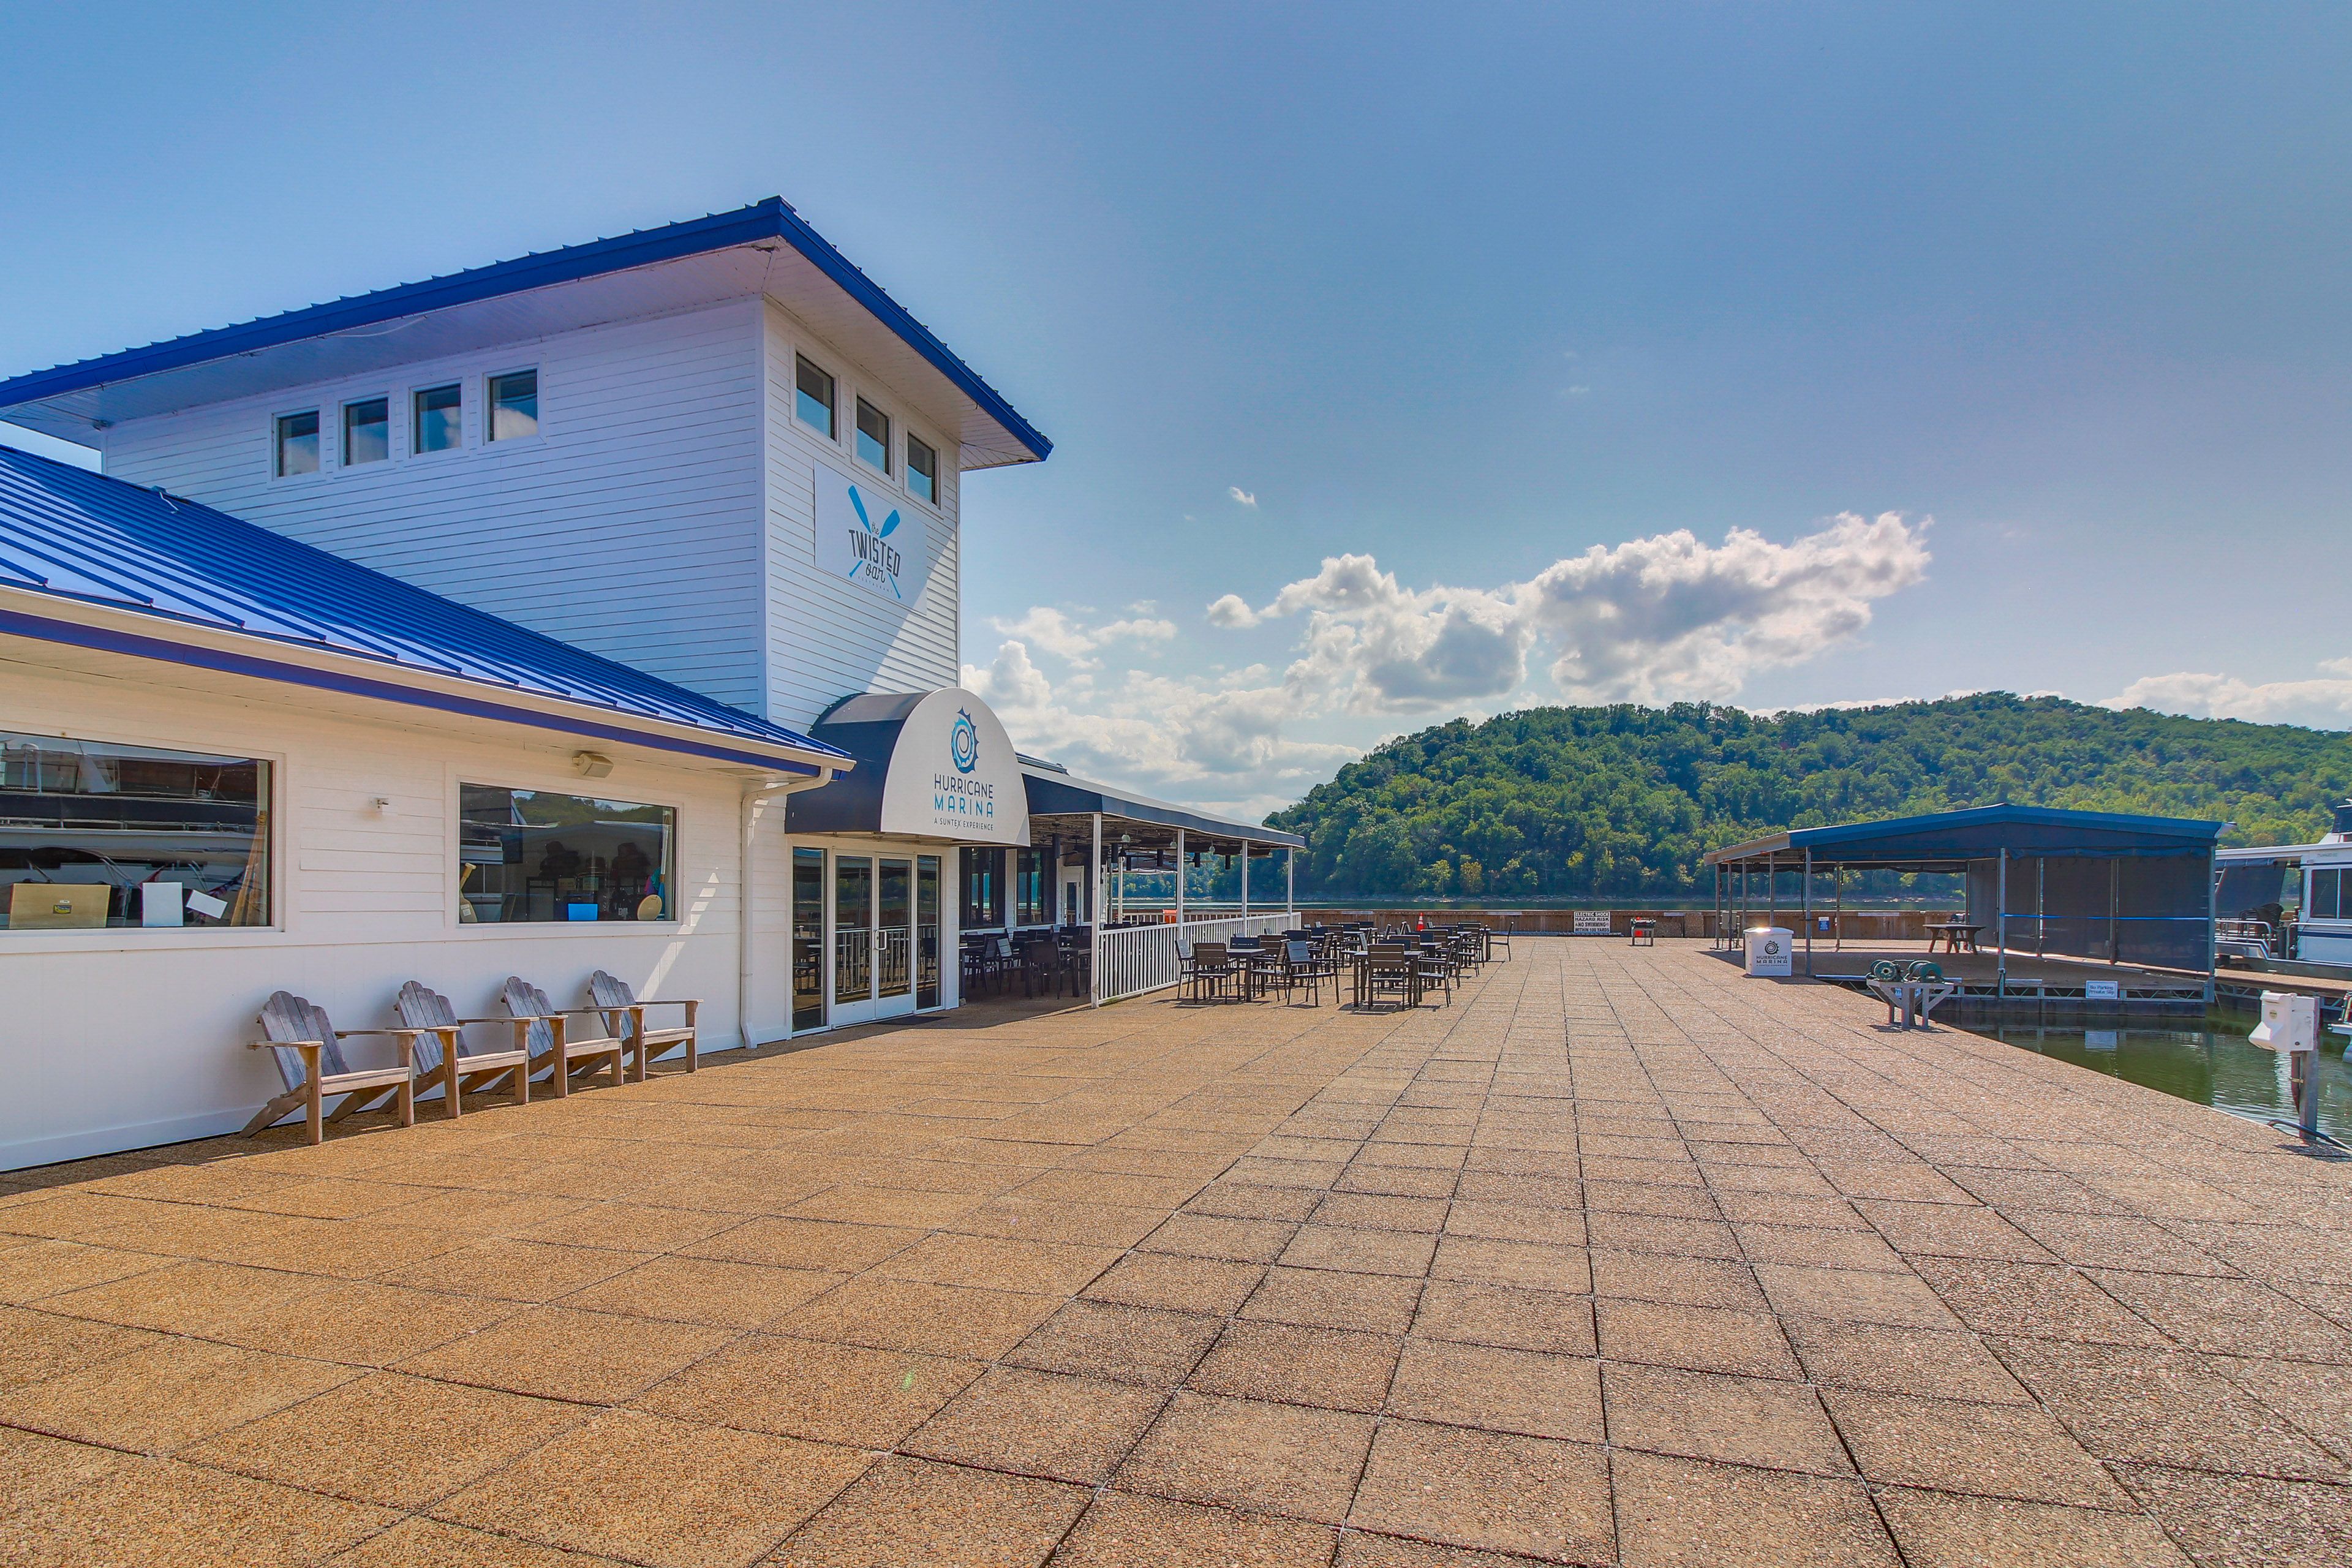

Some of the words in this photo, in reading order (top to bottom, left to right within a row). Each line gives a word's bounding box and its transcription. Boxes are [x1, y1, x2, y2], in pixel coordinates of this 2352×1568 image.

[871, 521, 880, 535] the
[848, 529, 901, 578] TWISTED
[934, 773, 993, 799] HURRICANE
[934, 793, 993, 818] MARINA
[940, 818, 961, 829] SUNTEX
[963, 821, 993, 831] EXPERIENCE
